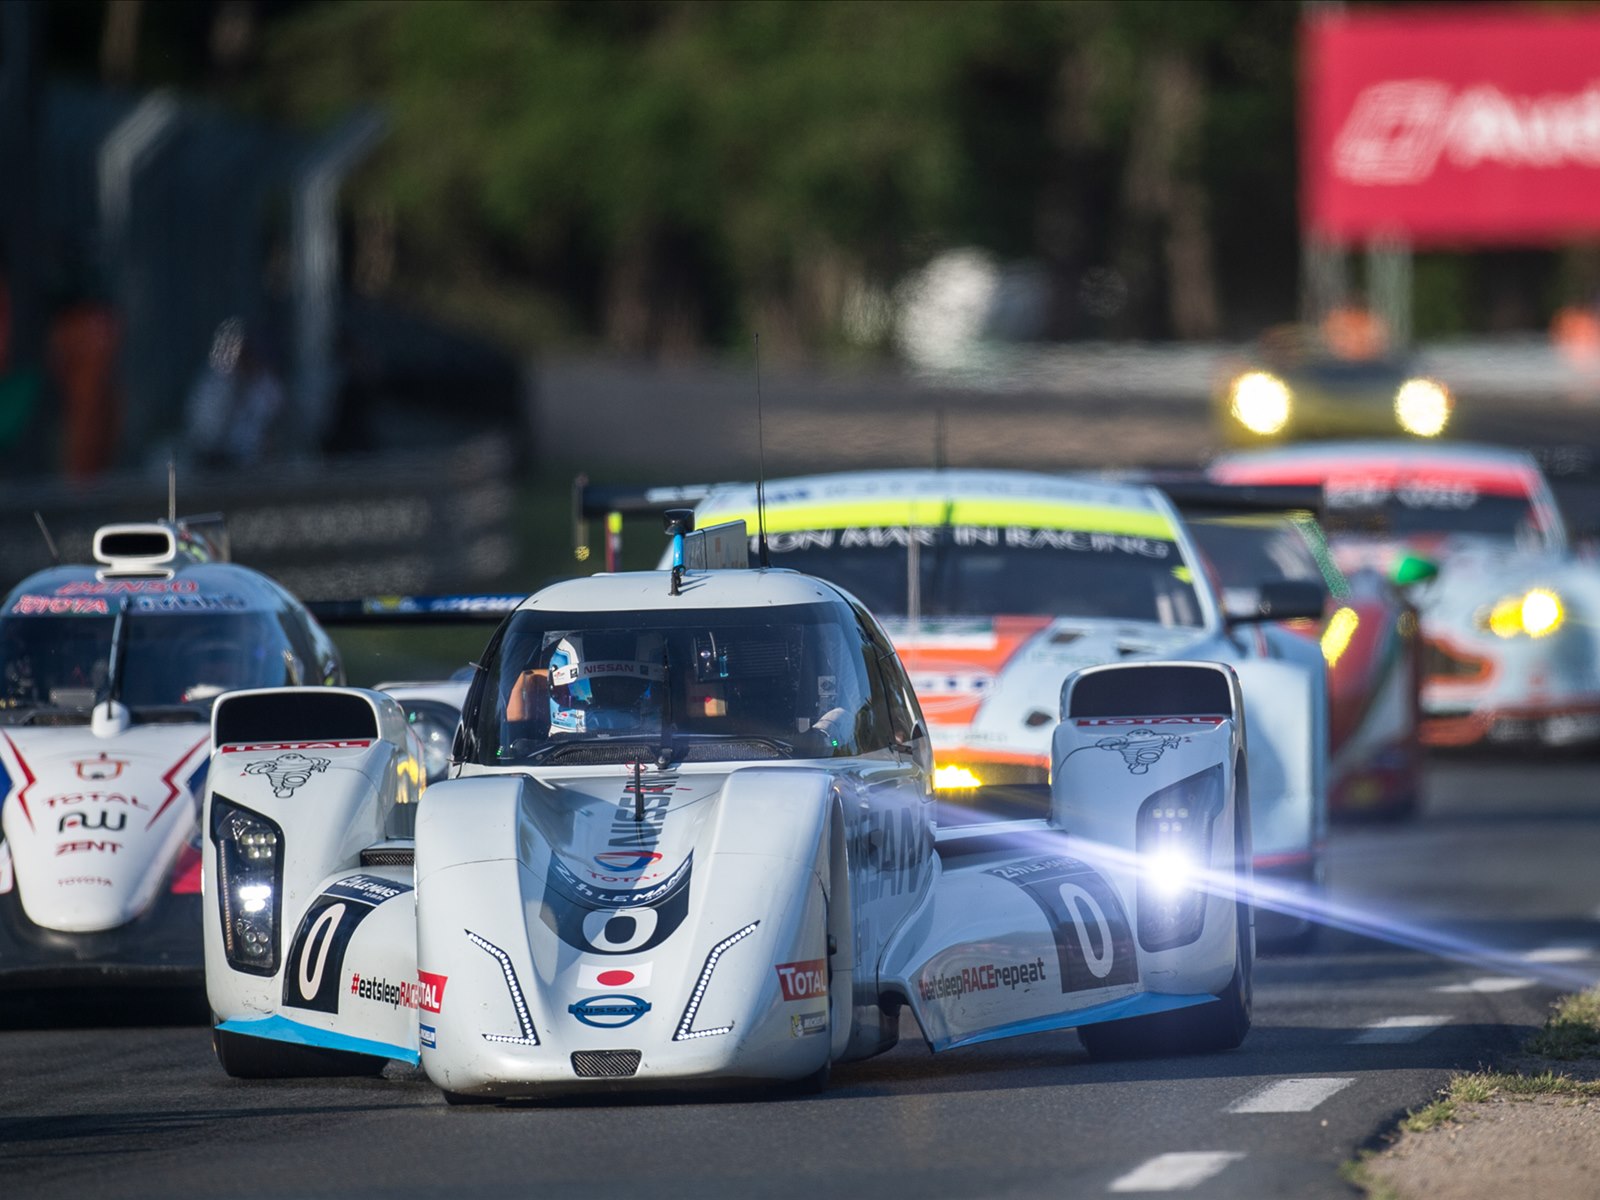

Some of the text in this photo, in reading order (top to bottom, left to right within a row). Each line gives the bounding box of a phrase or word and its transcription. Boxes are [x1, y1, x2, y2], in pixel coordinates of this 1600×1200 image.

[583, 664, 635, 674] NISSAN
[227, 742, 362, 751] TOTAL
[43, 791, 150, 811] TOTAL
[56, 840, 124, 856] ZENT
[586, 868, 665, 883] TOTAL
[598, 891, 630, 902] LE
[632, 858, 692, 902] MANS
[582, 906, 658, 952] 0
[1059, 883, 1114, 978] 0
[299, 903, 346, 1000] 0
[779, 967, 827, 996] TOTAL
[576, 1004, 645, 1014] NISSAN
